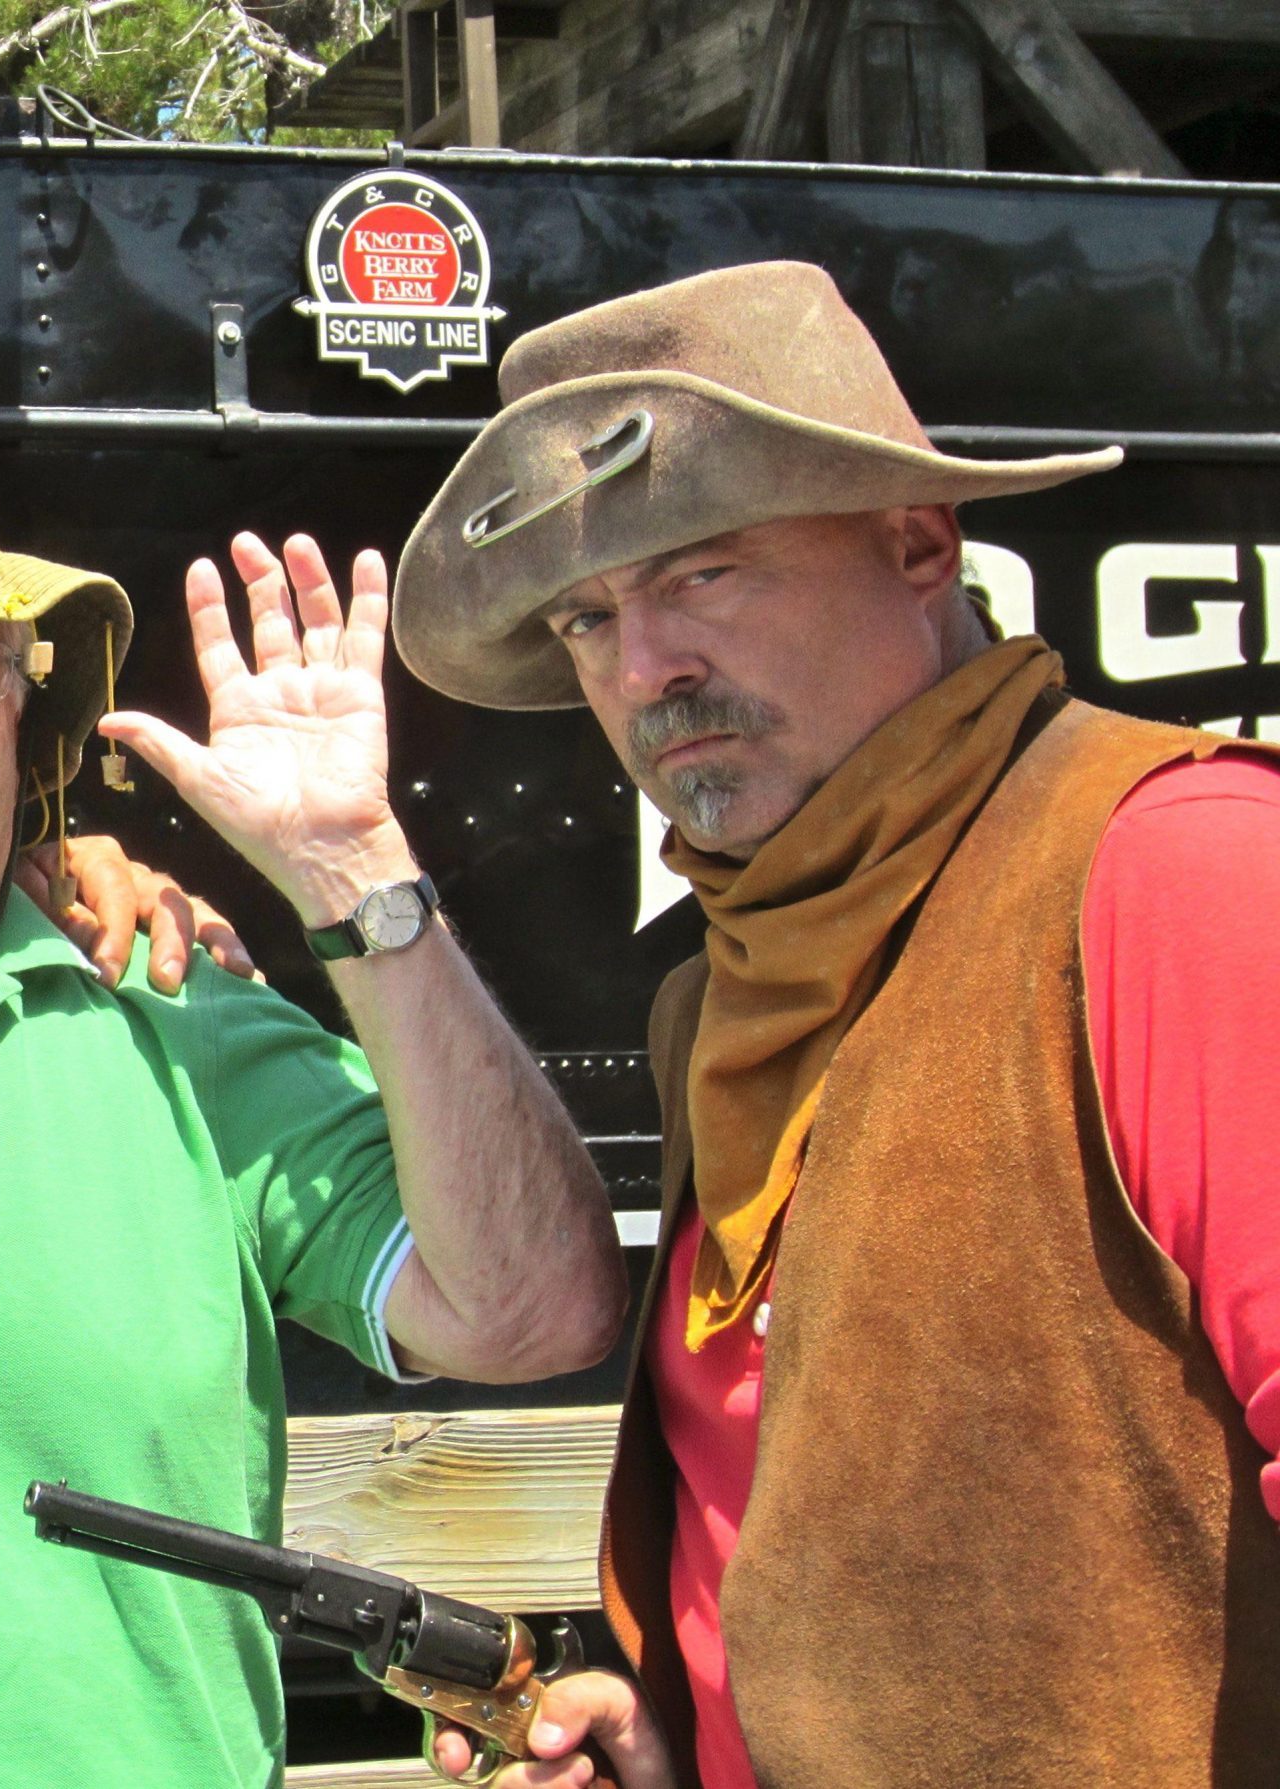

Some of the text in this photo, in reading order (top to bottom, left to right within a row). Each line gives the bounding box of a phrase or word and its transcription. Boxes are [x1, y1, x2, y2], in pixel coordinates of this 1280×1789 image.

[363, 254, 439, 278] BERRY
[372, 279, 438, 303] FARM
[329, 319, 478, 348] SCENIC LINE
[1096, 542, 1280, 683] G
